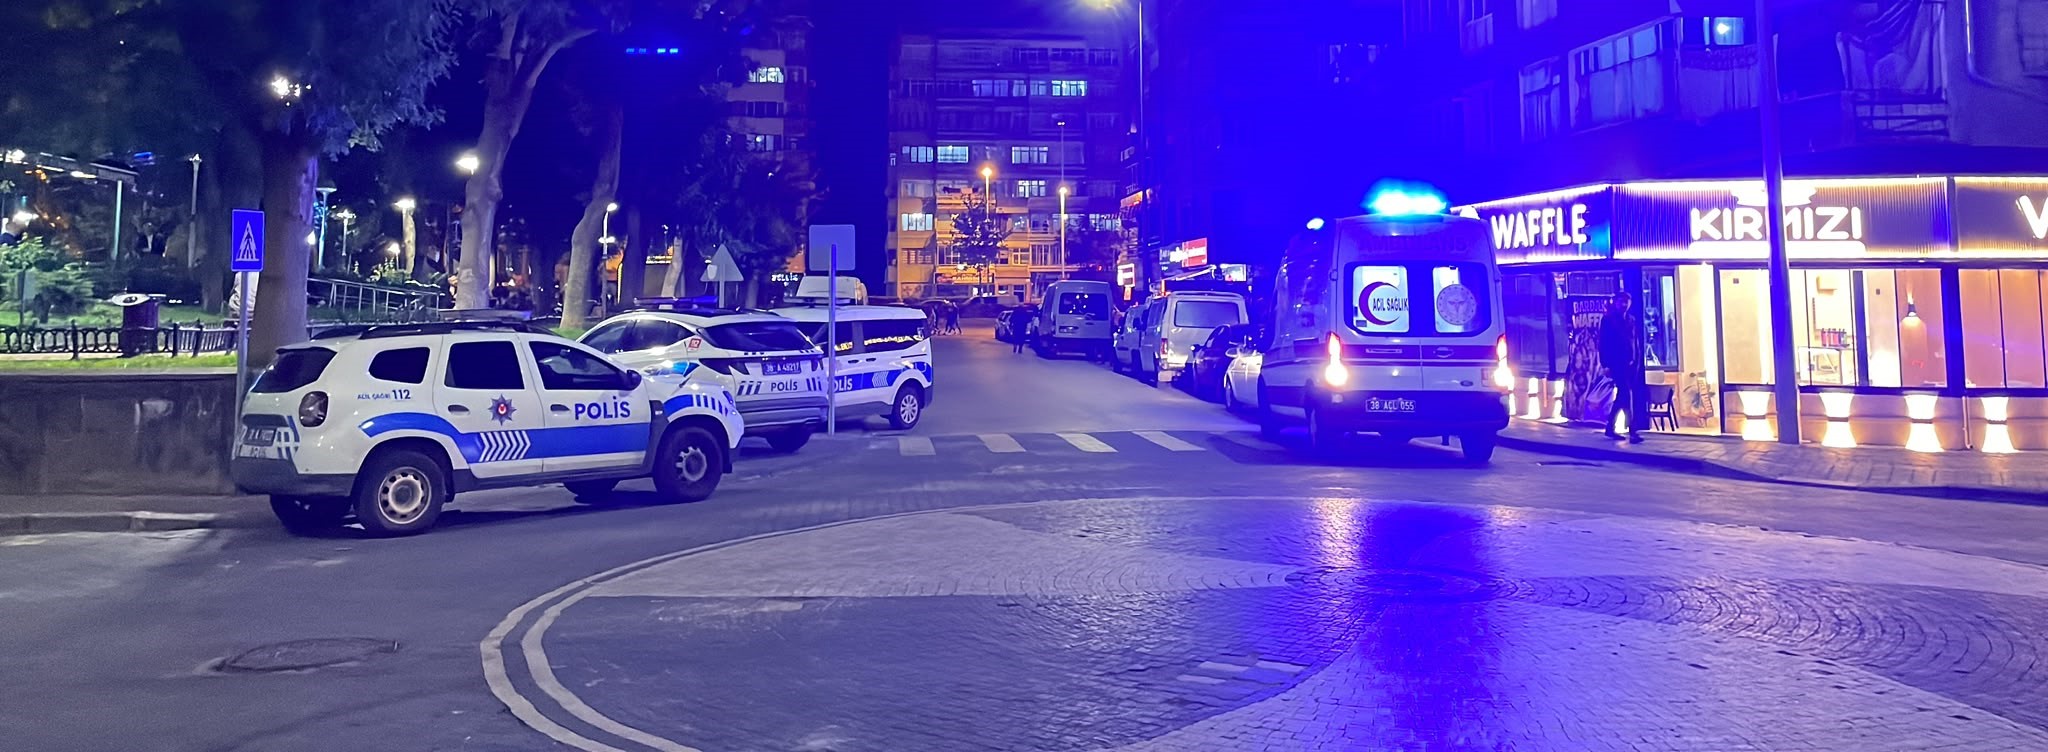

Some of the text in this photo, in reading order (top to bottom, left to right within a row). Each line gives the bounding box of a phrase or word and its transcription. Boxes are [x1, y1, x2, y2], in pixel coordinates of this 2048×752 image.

[1491, 203, 1588, 249] WAFFLE
[1572, 312, 1604, 329] WAFF
[771, 379, 798, 392] POLİS
[835, 376, 853, 392] OLİS
[391, 389, 412, 400] 112
[575, 396, 631, 420] POLİS
[1370, 401, 1415, 410] 38 ACL 055
